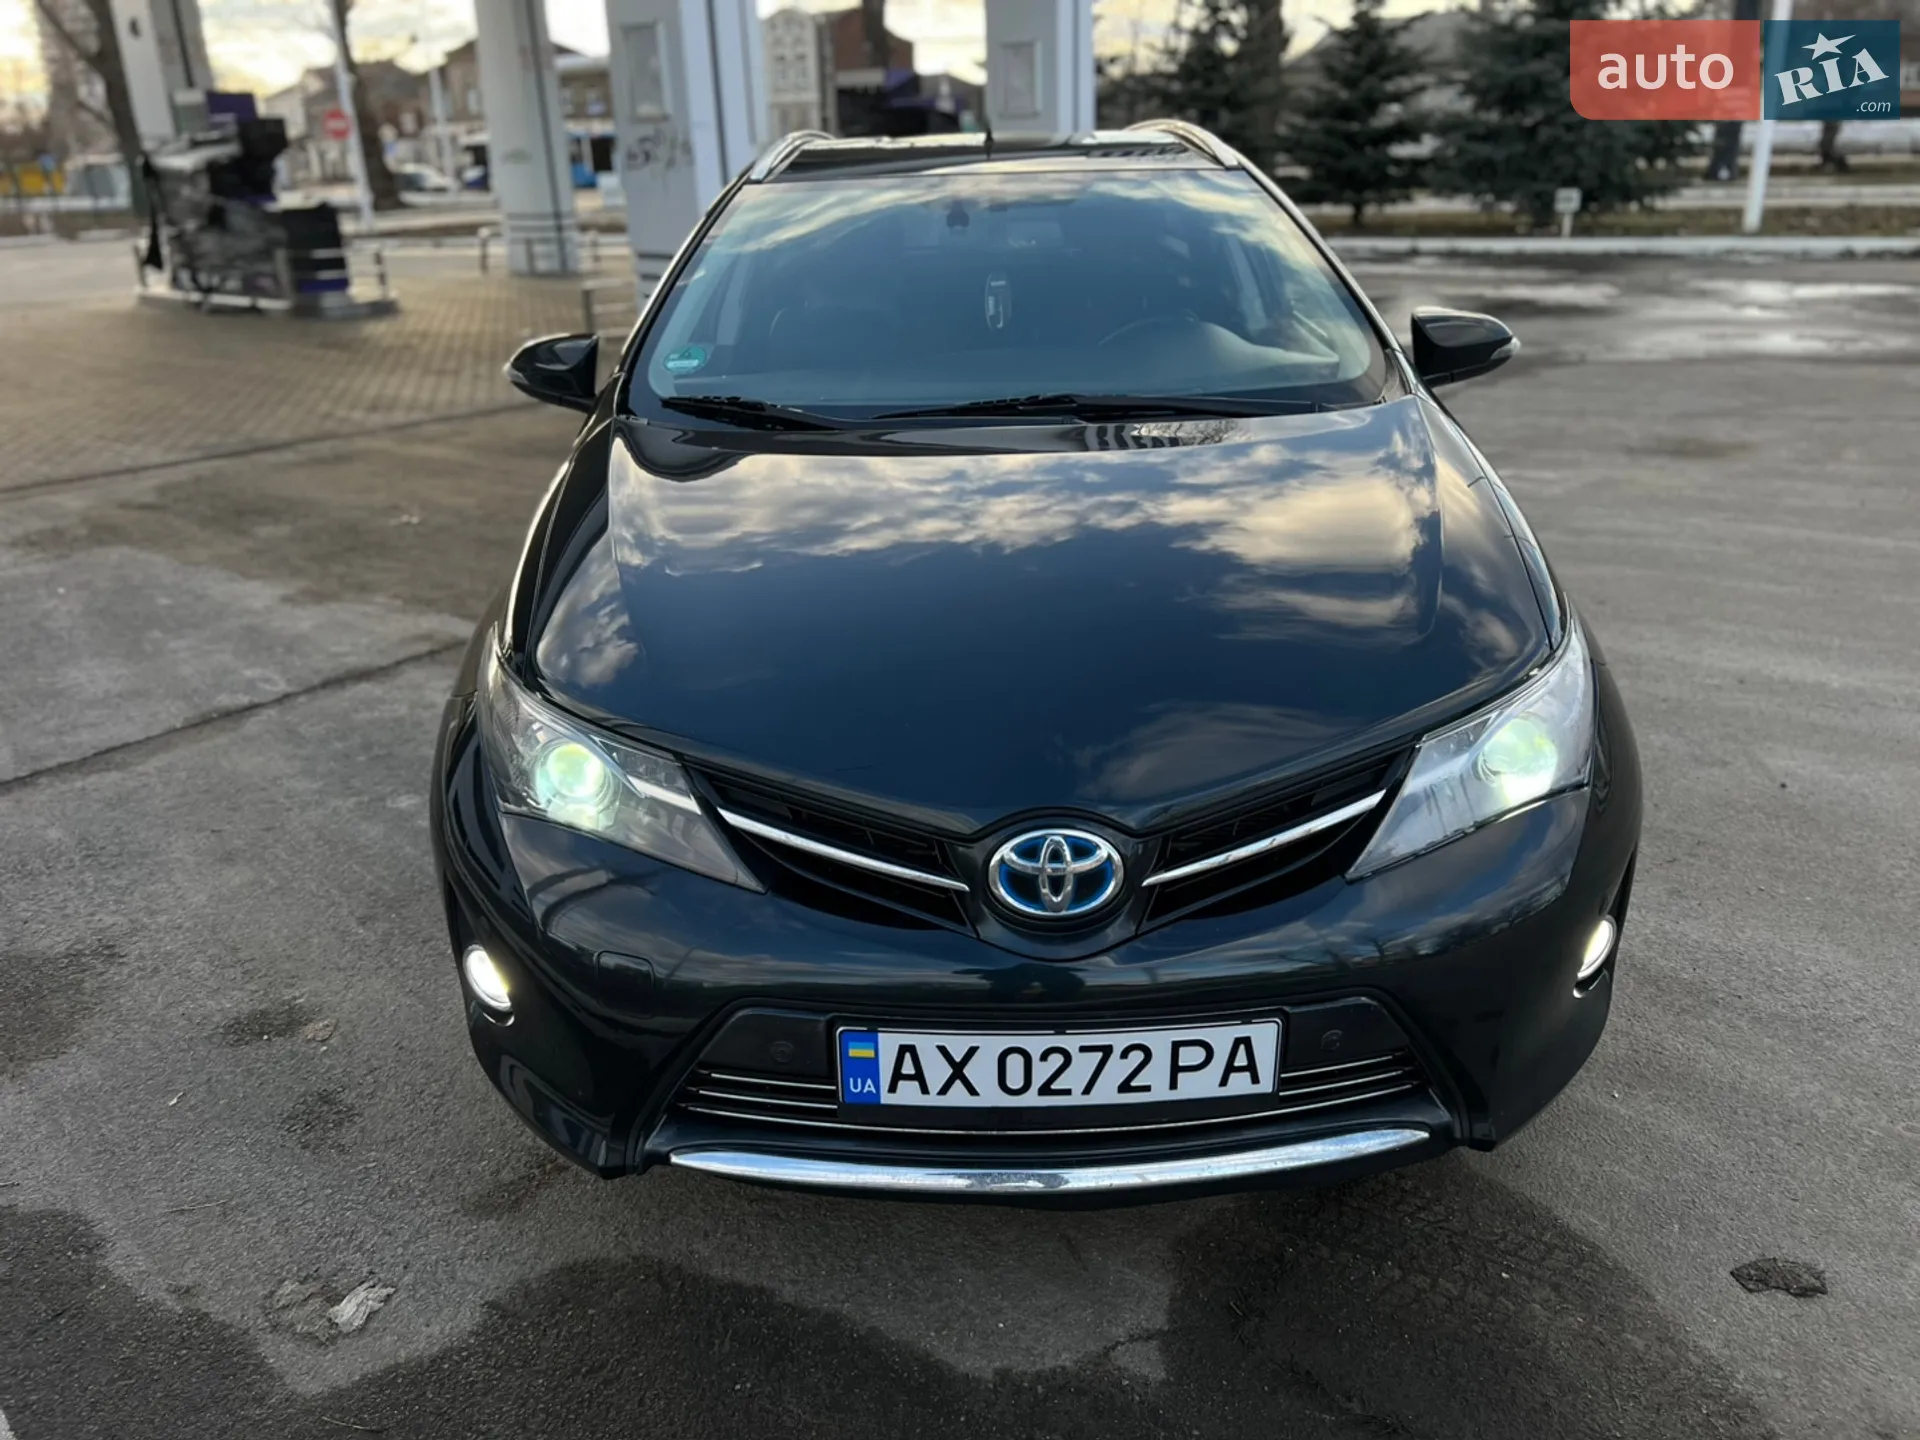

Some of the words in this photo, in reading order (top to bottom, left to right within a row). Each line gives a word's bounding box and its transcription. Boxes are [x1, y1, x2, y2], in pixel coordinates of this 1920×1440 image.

[849, 1077, 877, 1094] UA
[887, 1043, 981, 1097] AX
[997, 1043, 1153, 1097] 0272
[1168, 1035, 1261, 1091] PA
